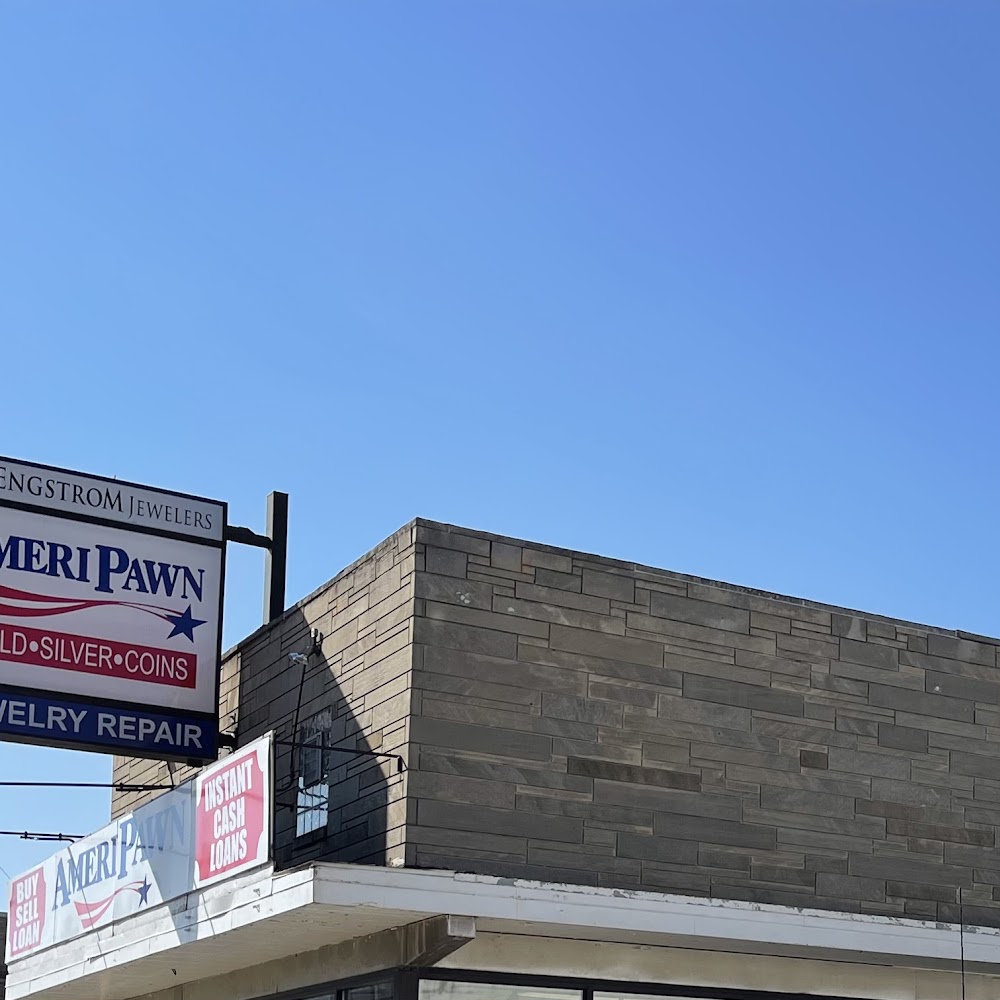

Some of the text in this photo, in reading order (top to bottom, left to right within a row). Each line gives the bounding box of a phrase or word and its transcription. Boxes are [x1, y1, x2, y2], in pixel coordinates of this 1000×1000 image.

[128, 495, 213, 530] JEWELERS
[97, 712, 203, 749] REPAIR
[205, 758, 254, 812] INSTANT
[213, 796, 246, 840] CASH
[52, 800, 188, 912] AMERIPAWN
[209, 828, 248, 872] LOANS
[16, 872, 40, 905] BUY
[15, 897, 39, 928] SELL
[12, 920, 41, 952] LOAN
